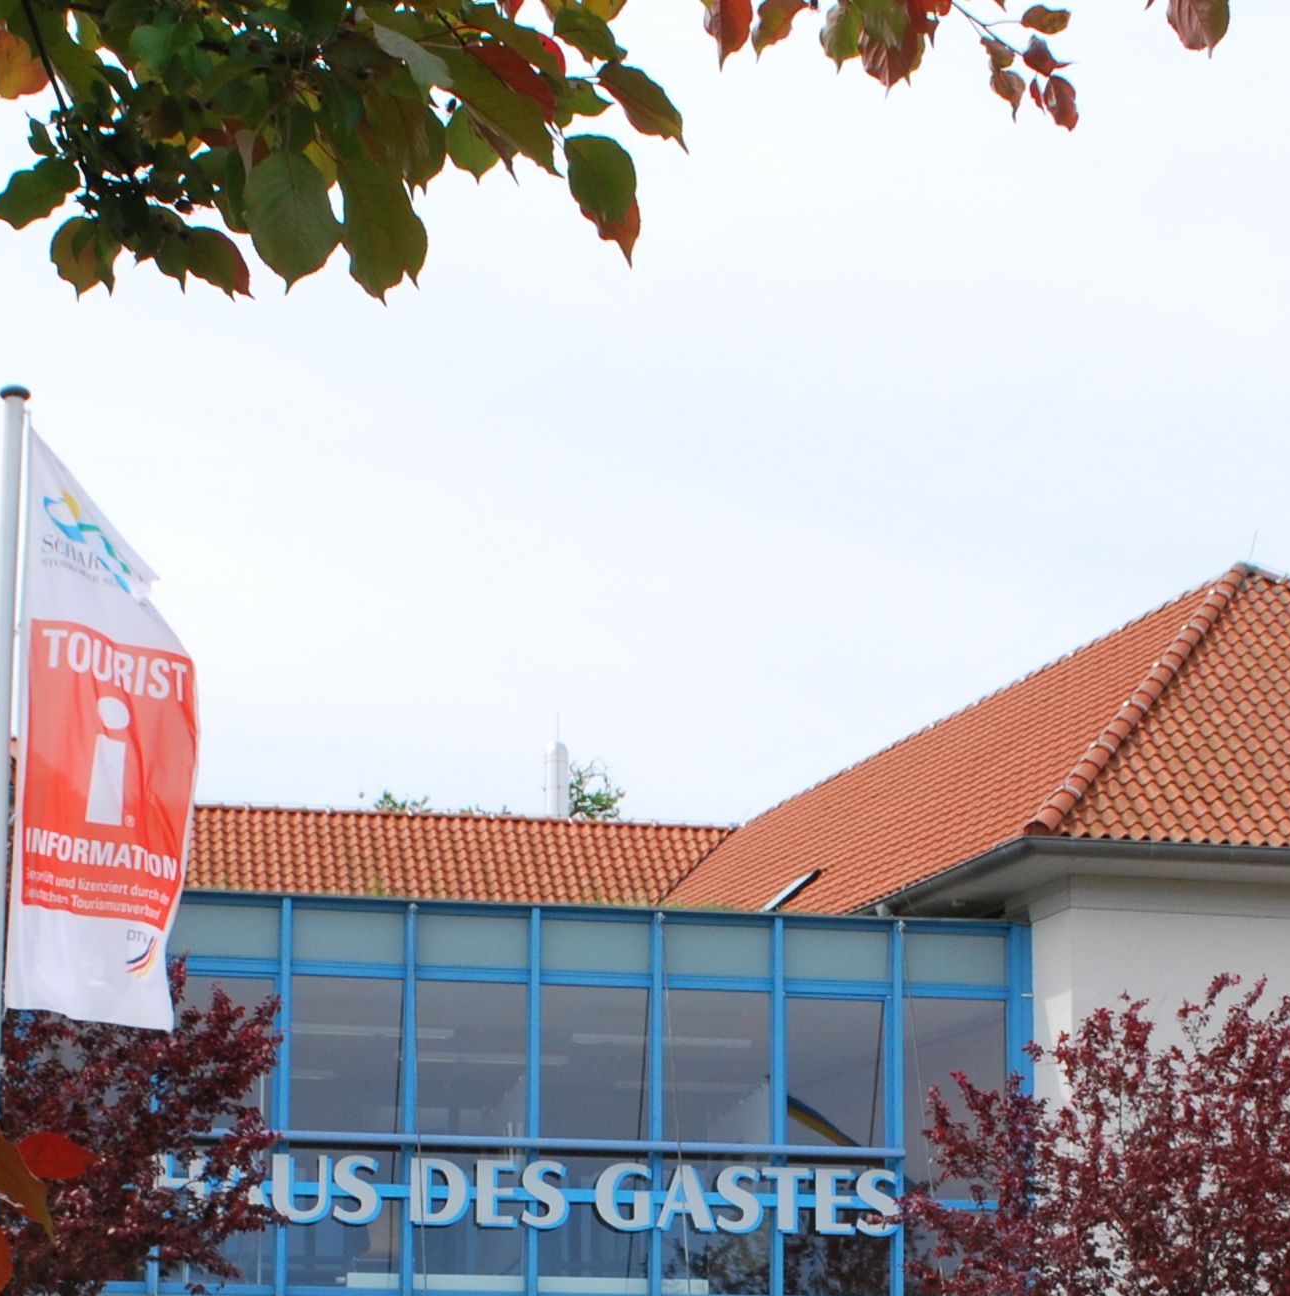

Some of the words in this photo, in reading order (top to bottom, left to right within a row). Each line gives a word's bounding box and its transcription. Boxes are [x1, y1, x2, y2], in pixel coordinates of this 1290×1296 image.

[42, 629, 188, 704] TOURIST
[26, 828, 177, 881] INFORMATION
[55, 875, 76, 889] und
[78, 878, 128, 896] lizenziert
[130, 884, 159, 901] durch
[410, 1157, 570, 1232] DES
[595, 1162, 904, 1236] GASTES
